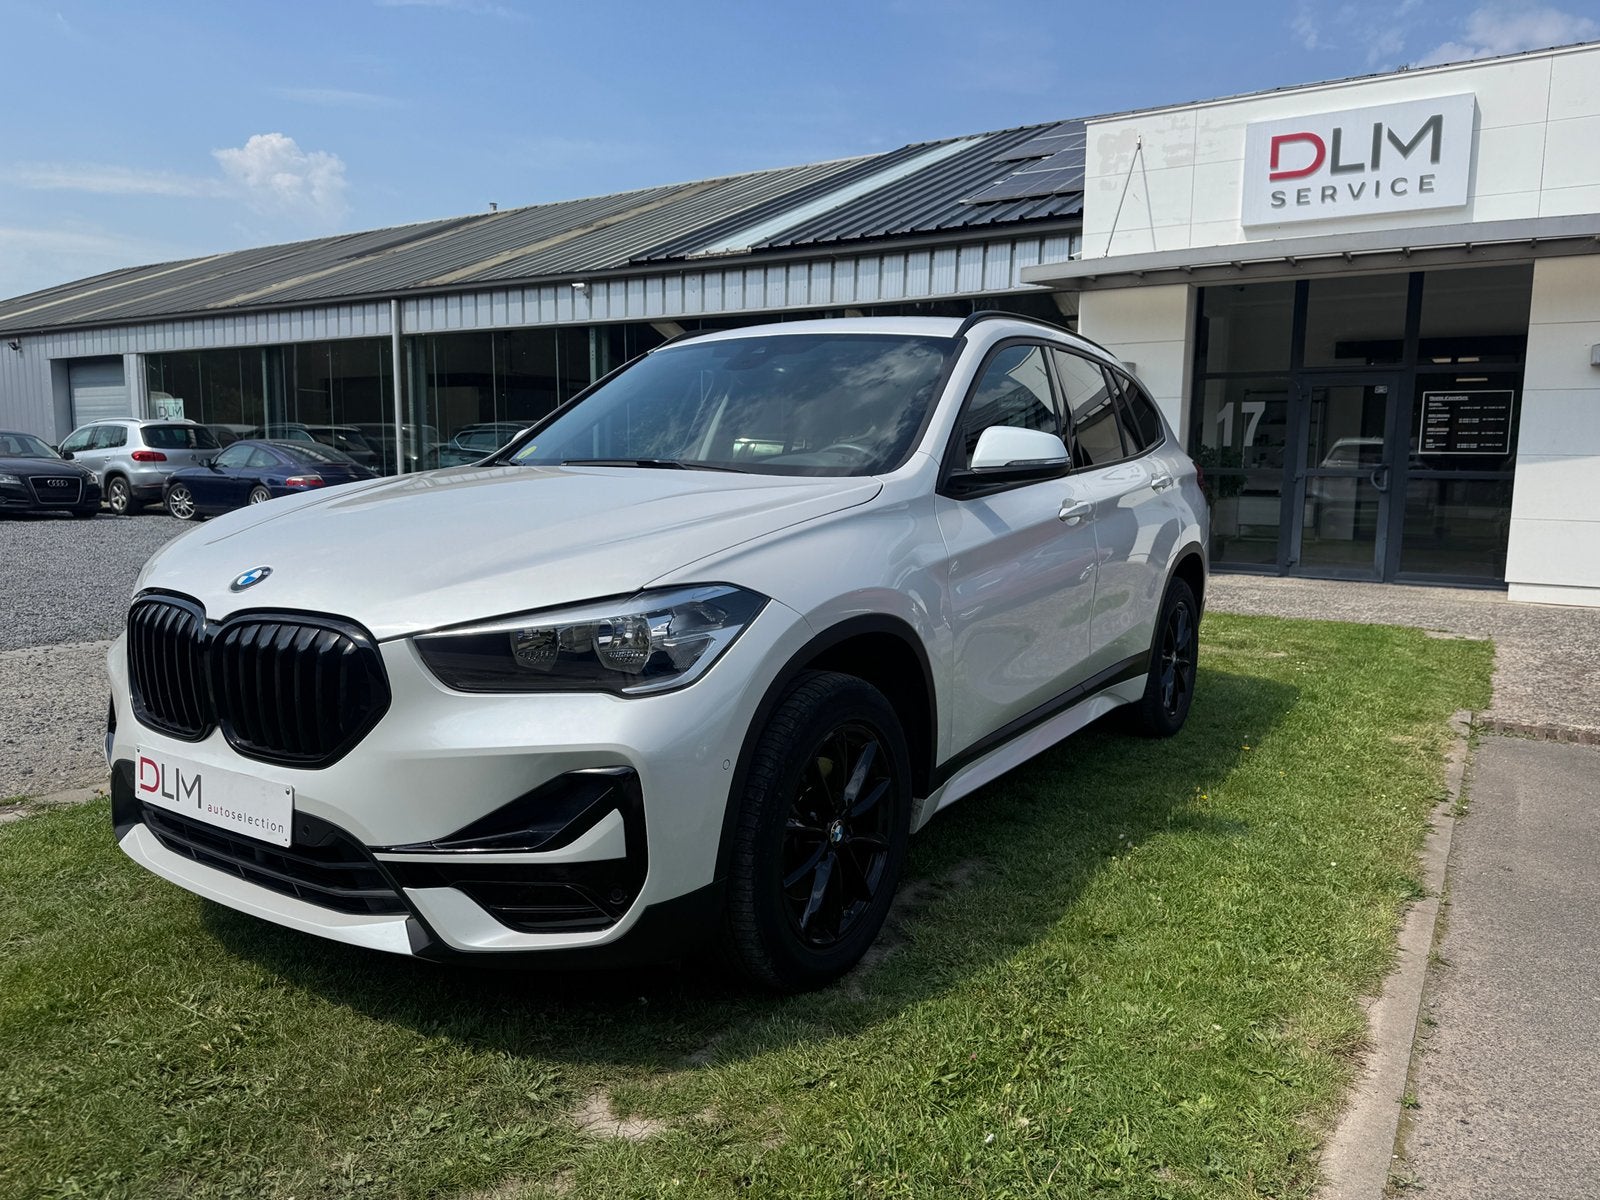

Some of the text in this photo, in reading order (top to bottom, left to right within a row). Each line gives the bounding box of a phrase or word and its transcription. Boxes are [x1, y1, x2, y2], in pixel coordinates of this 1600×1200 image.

[1269, 114, 1443, 182] DLM
[1271, 173, 1436, 208] SERVICE
[1216, 401, 1266, 447] 17
[139, 756, 202, 809] DLM
[207, 803, 284, 834] autoselection
